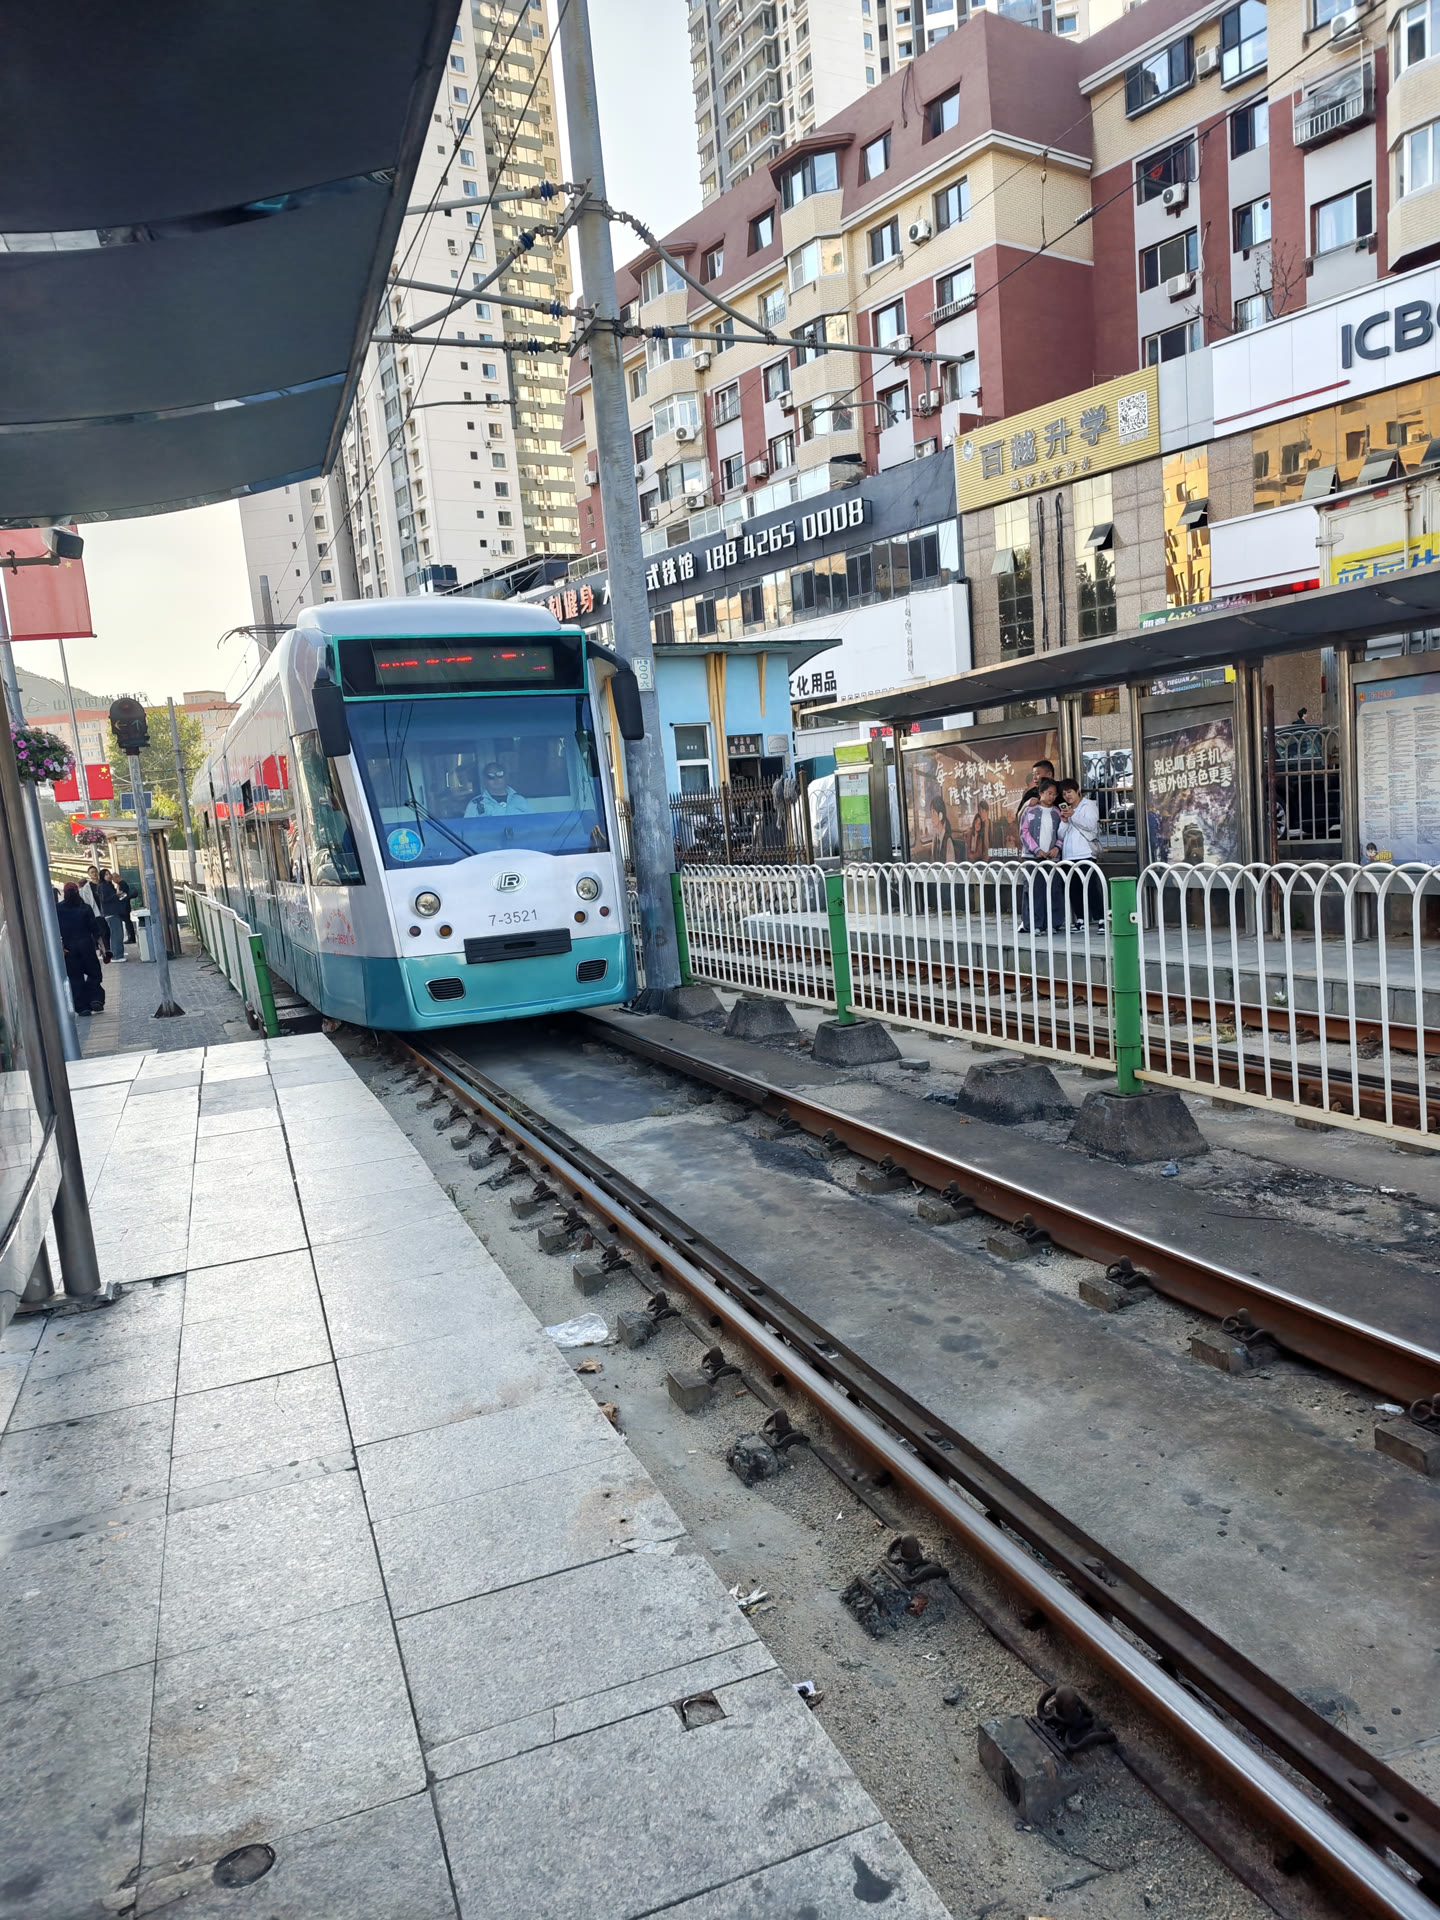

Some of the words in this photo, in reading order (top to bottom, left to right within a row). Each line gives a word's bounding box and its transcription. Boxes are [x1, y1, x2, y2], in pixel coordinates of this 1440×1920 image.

[1341, 299, 1440, 369] ICB
[979, 404, 1111, 480] 百越升学
[535, 584, 594, 621] 刻健身
[705, 540, 738, 573] 188
[743, 520, 795, 558] 4265
[802, 497, 864, 542] 0008
[1148, 766, 1232, 795] 车窗外的景色更美
[488, 909, 537, 926] 7-3521
